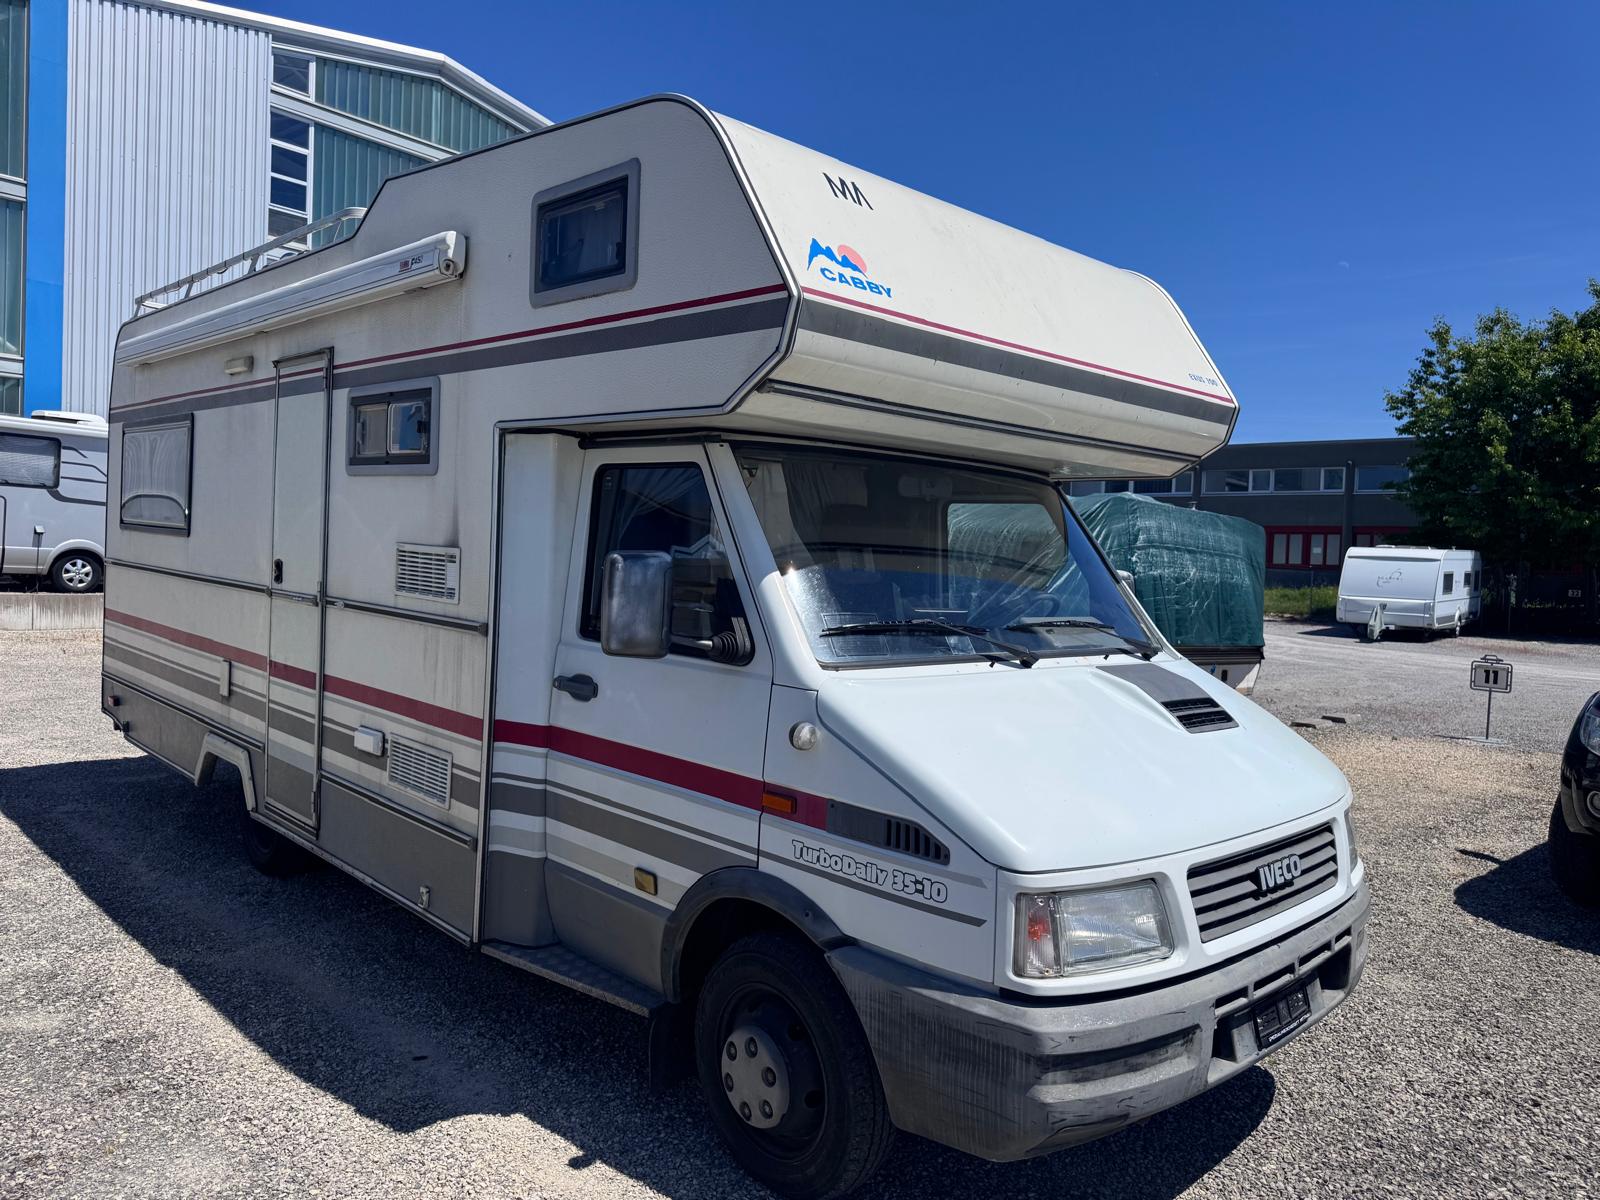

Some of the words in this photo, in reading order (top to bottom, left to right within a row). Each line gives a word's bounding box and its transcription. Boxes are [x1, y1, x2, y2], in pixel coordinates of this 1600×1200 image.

[820, 267, 893, 299] CABBY
[1484, 669, 1499, 685] 11
[791, 840, 888, 886] TurboDaily
[892, 869, 948, 903] 35-10
[1259, 854, 1303, 891] IVECO
